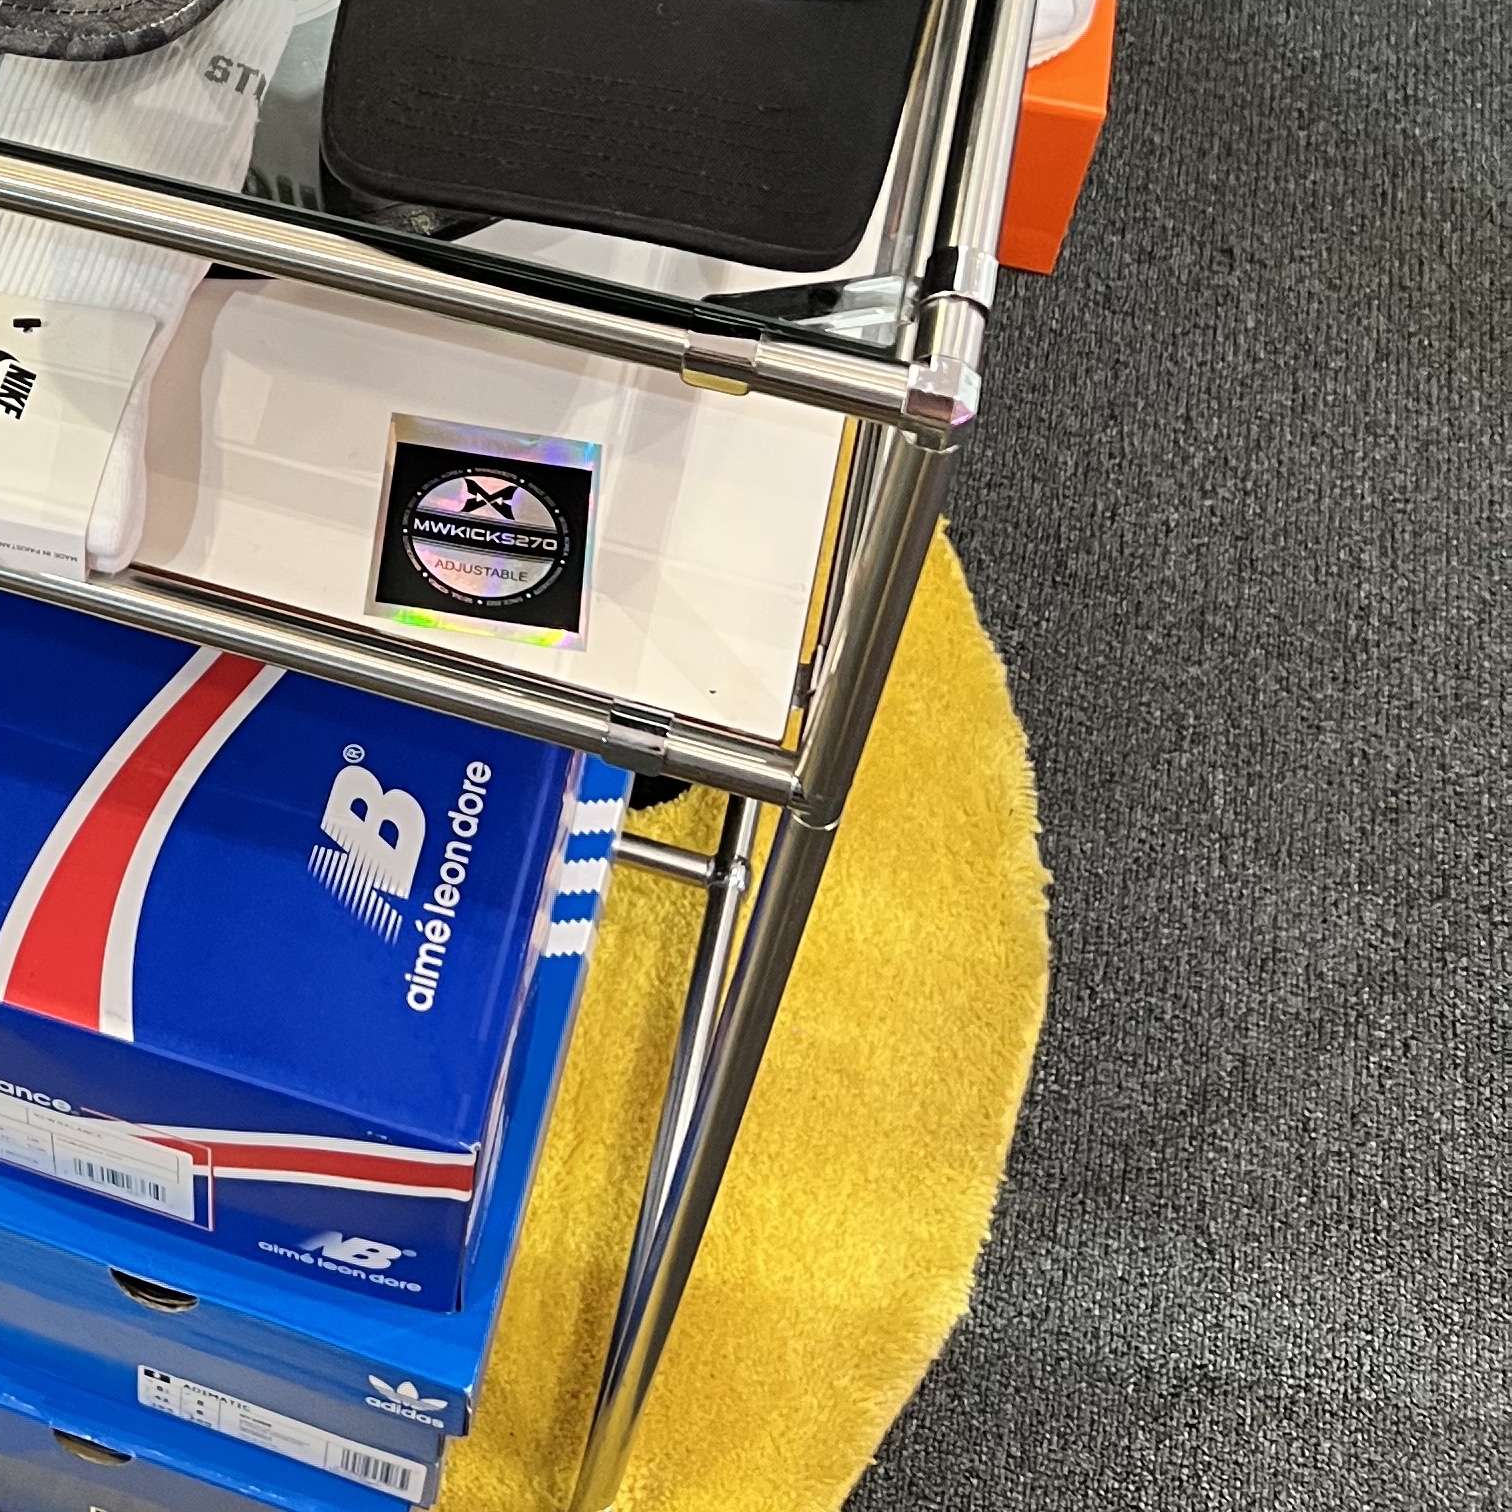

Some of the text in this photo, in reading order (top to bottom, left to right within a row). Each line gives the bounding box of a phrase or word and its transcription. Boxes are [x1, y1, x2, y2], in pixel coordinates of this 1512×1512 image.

[413, 517, 558, 551] MWKICKS270
[41, 548, 51, 557] IN
[53, 551, 78, 563] MADE
[434, 558, 528, 583] ADJUSTABLE
[403, 760, 492, 1013] aimé leon dore
[258, 1241, 422, 1292] aimé leon dore
[365, 1396, 445, 1429] adidas
